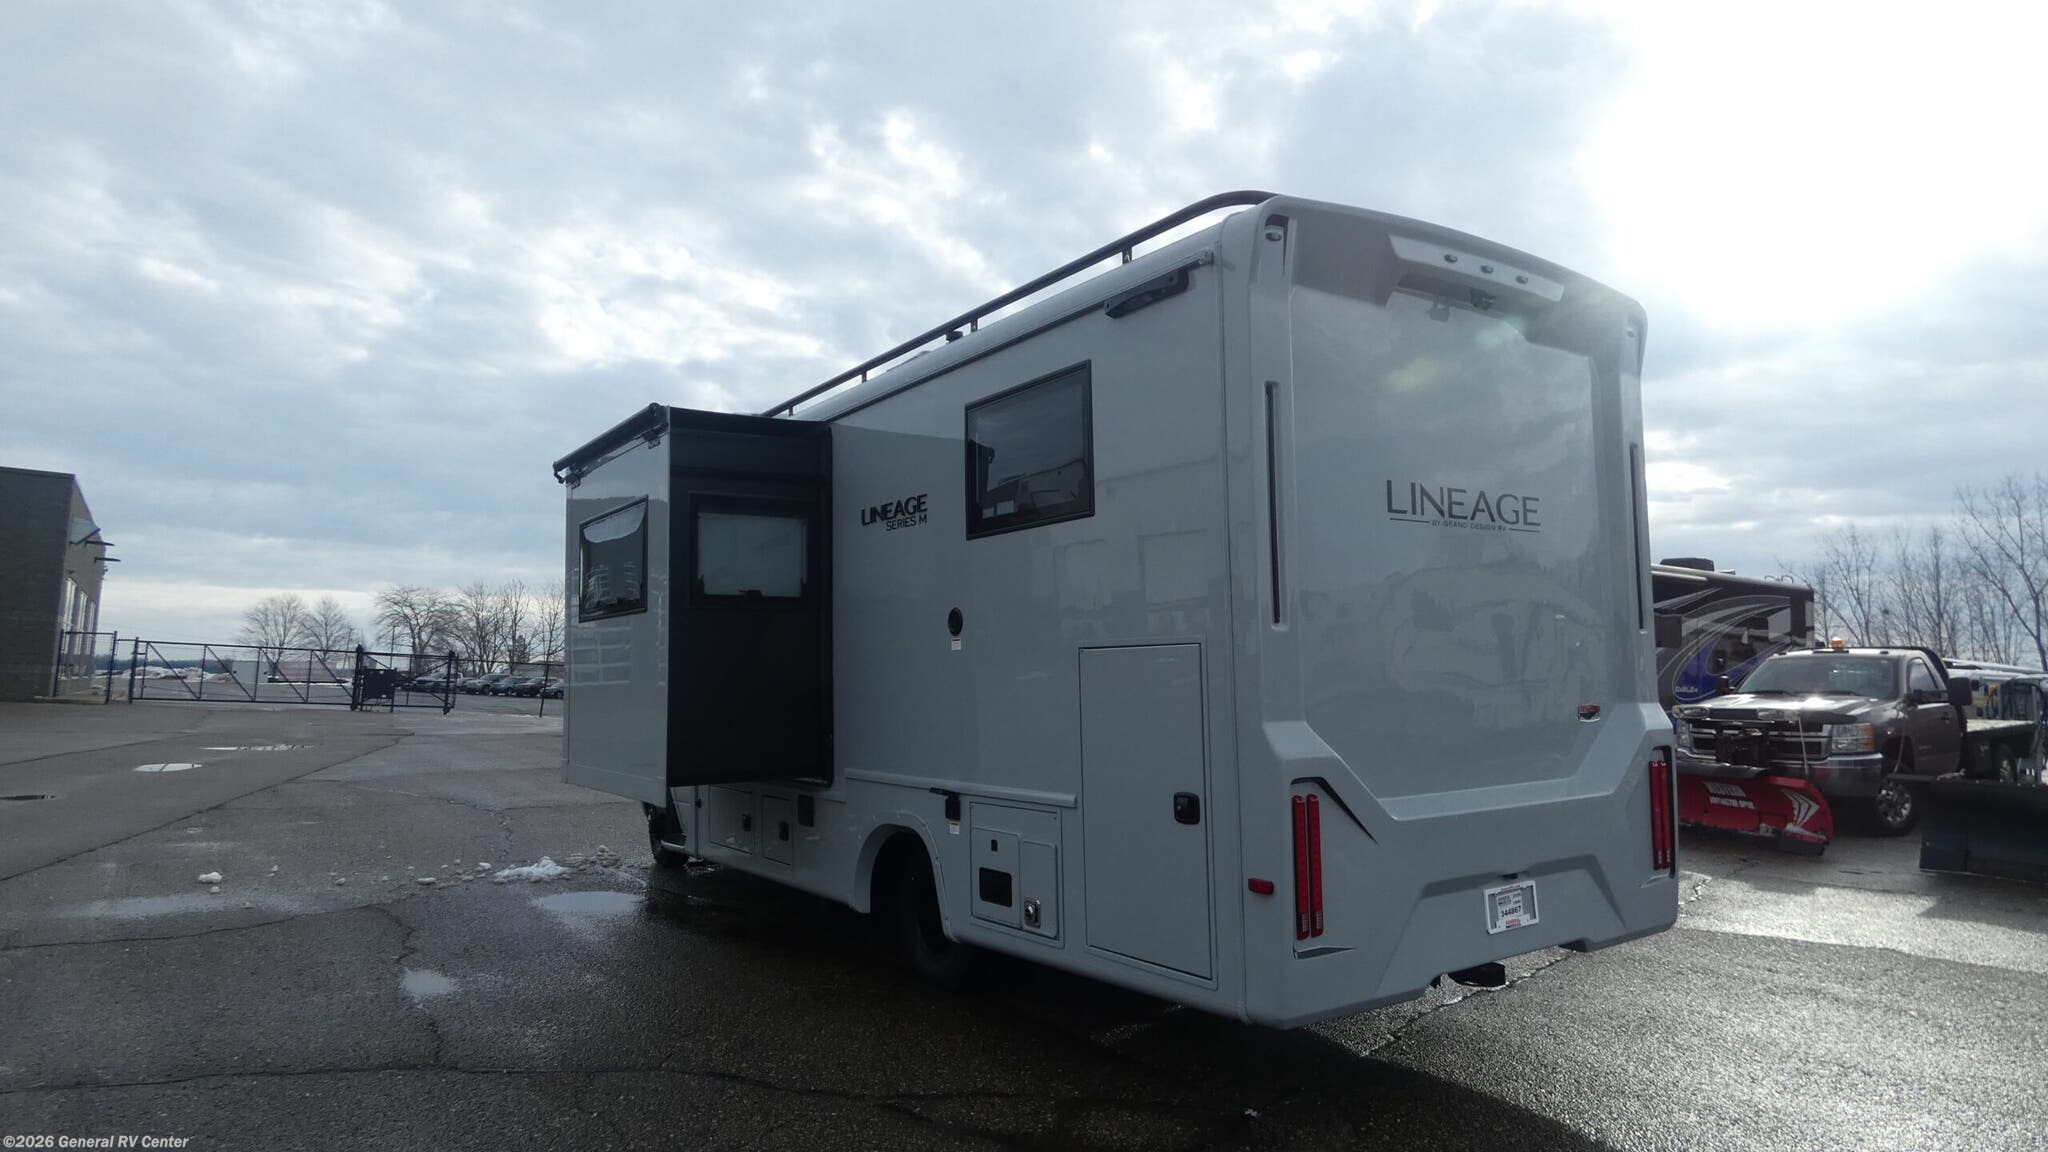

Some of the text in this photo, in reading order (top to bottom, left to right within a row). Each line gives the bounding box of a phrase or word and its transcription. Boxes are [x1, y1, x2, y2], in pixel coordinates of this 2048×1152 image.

[861, 494, 928, 526] LINEAGE
[1386, 479, 1541, 527] LINEAGE
[886, 514, 928, 531] SERIES M
[1432, 519, 1440, 527] BY
[1443, 520, 1467, 528] GRAND
[1470, 523, 1495, 531] DESIGN
